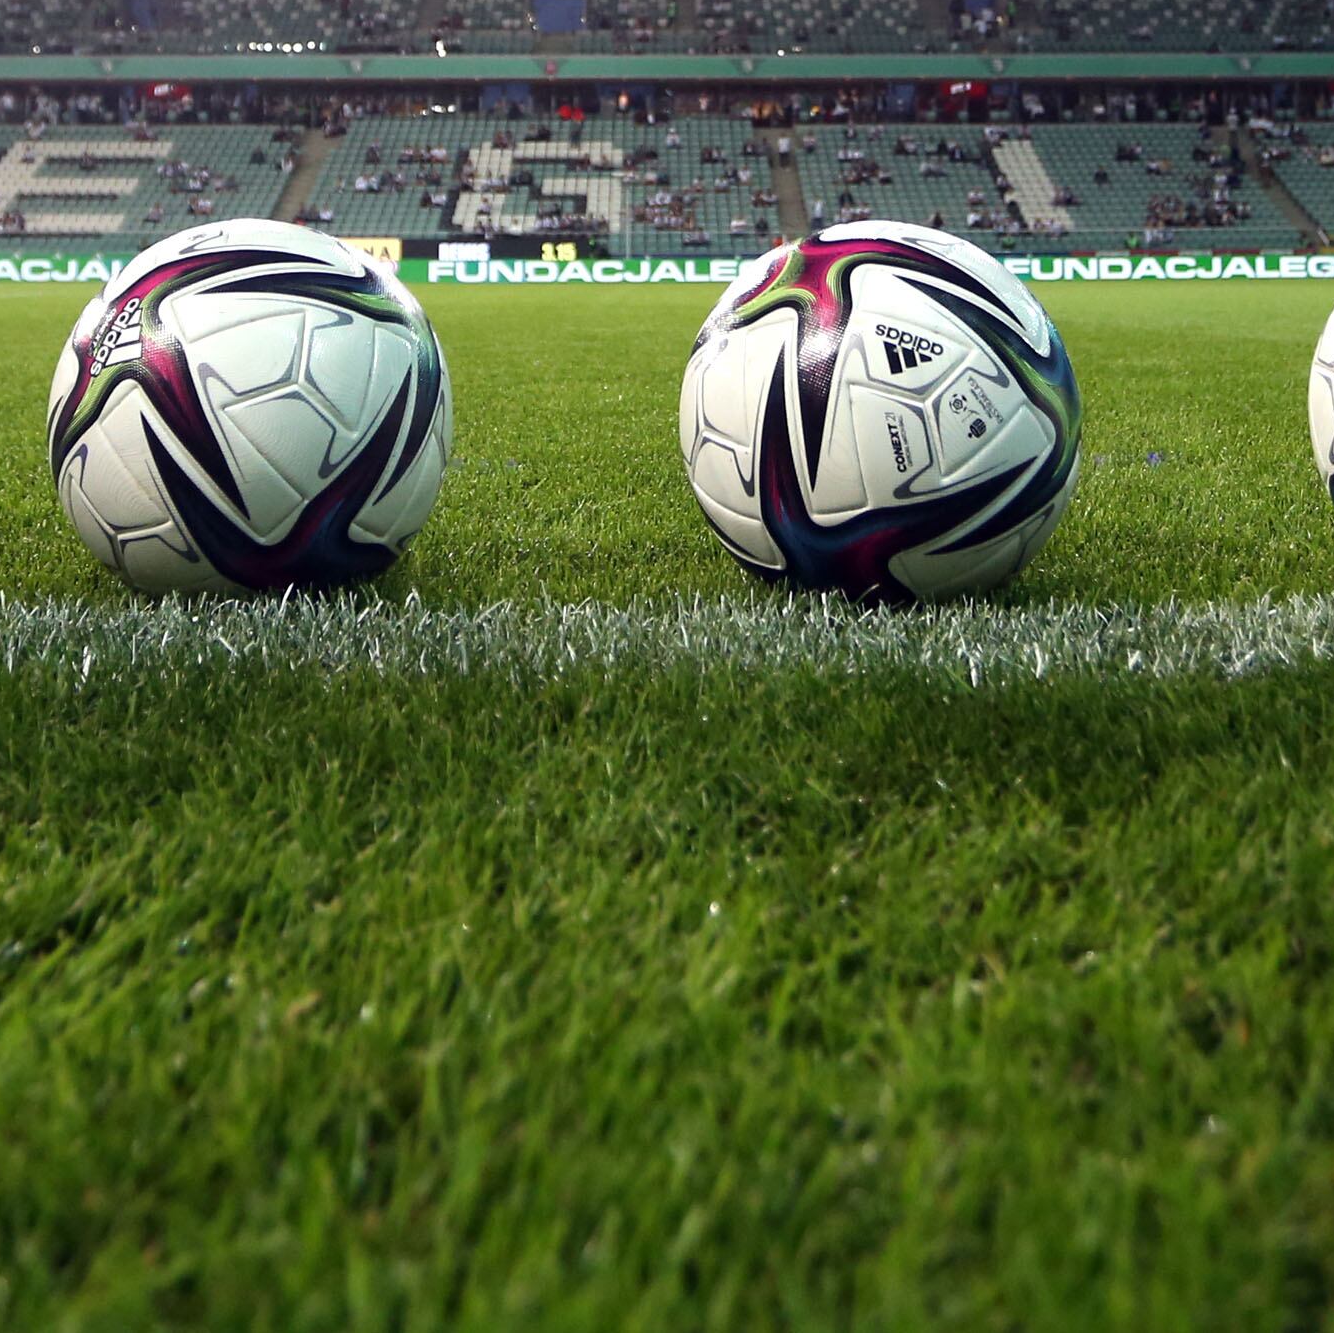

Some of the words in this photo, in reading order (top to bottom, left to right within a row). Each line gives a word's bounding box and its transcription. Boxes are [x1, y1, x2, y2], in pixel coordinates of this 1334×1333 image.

[90, 298, 140, 376] adidas
[875, 324, 944, 356] adidas
[884, 412, 896, 422] 21
[887, 423, 907, 473] CONEXT
